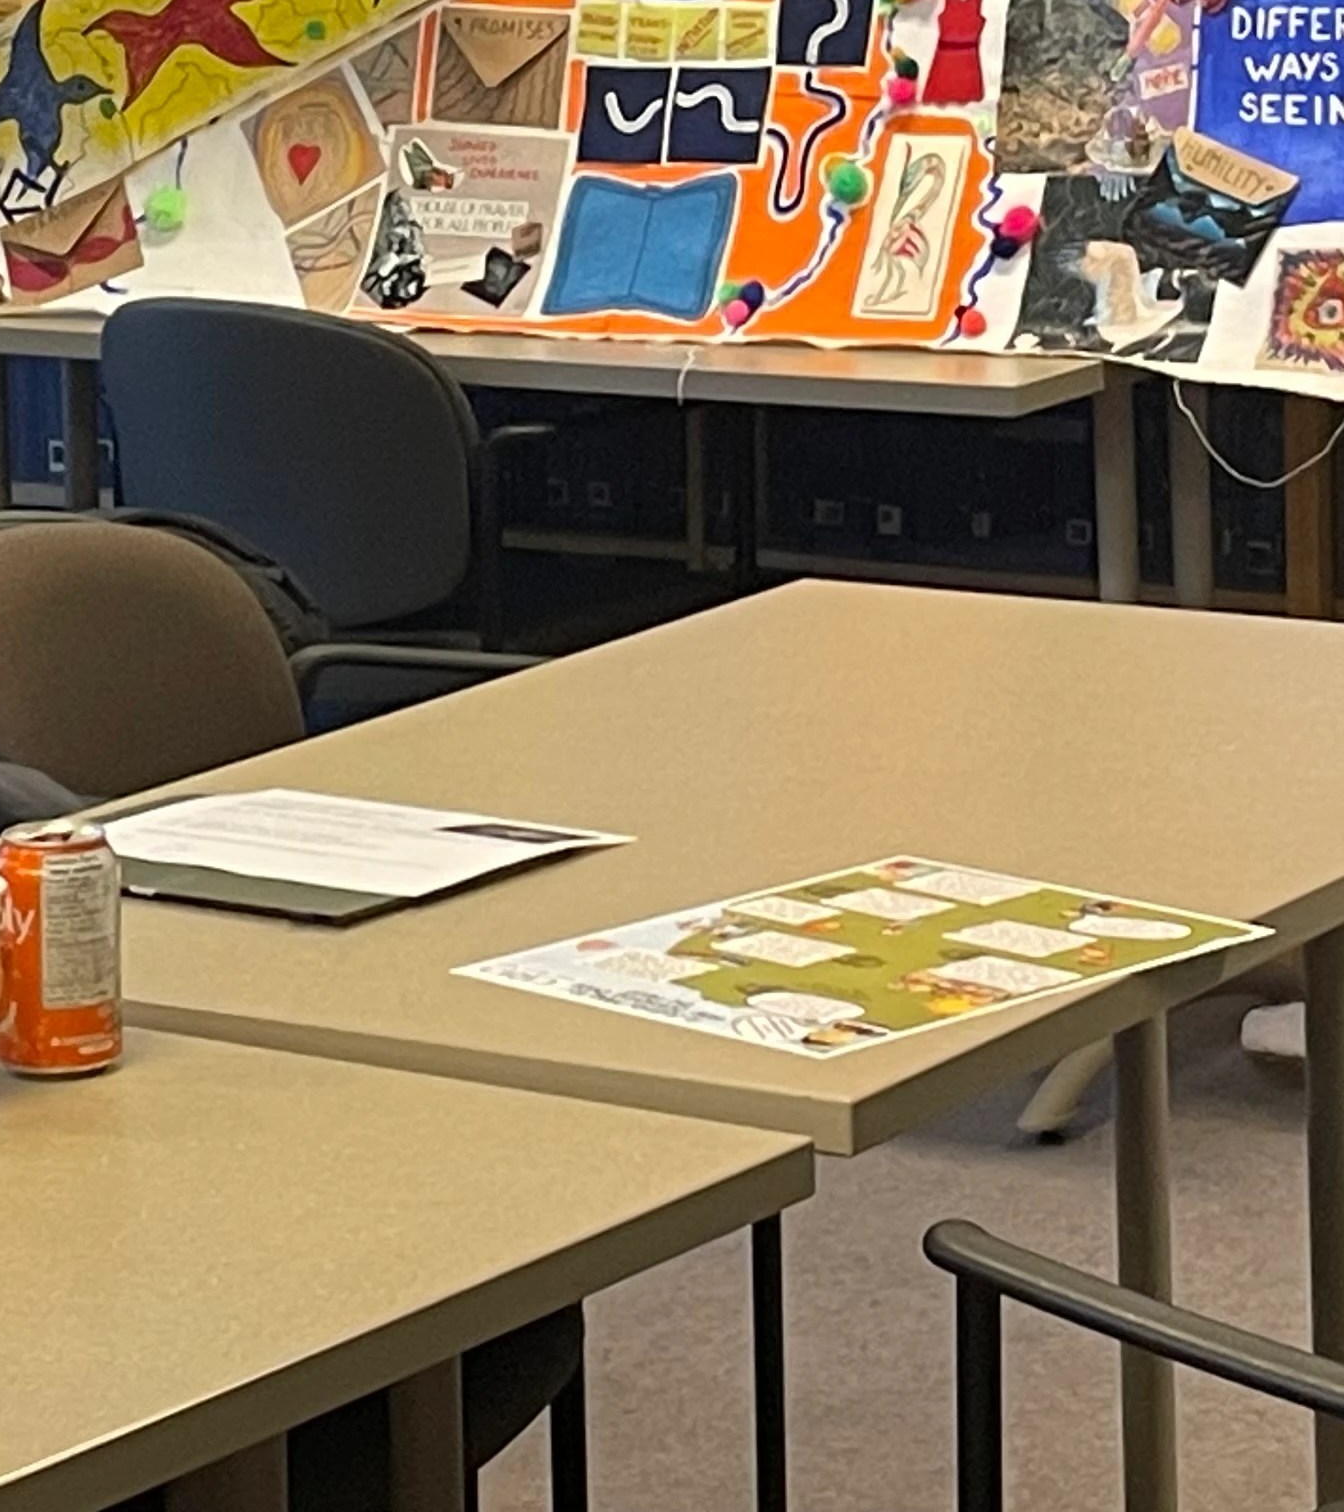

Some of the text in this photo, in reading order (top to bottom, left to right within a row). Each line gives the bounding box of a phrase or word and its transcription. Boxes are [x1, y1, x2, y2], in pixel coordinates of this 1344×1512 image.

[469, 16, 555, 41] PROMISES
[1244, 51, 1340, 83] WAYS
[1180, 136, 1269, 199] HUMILITY
